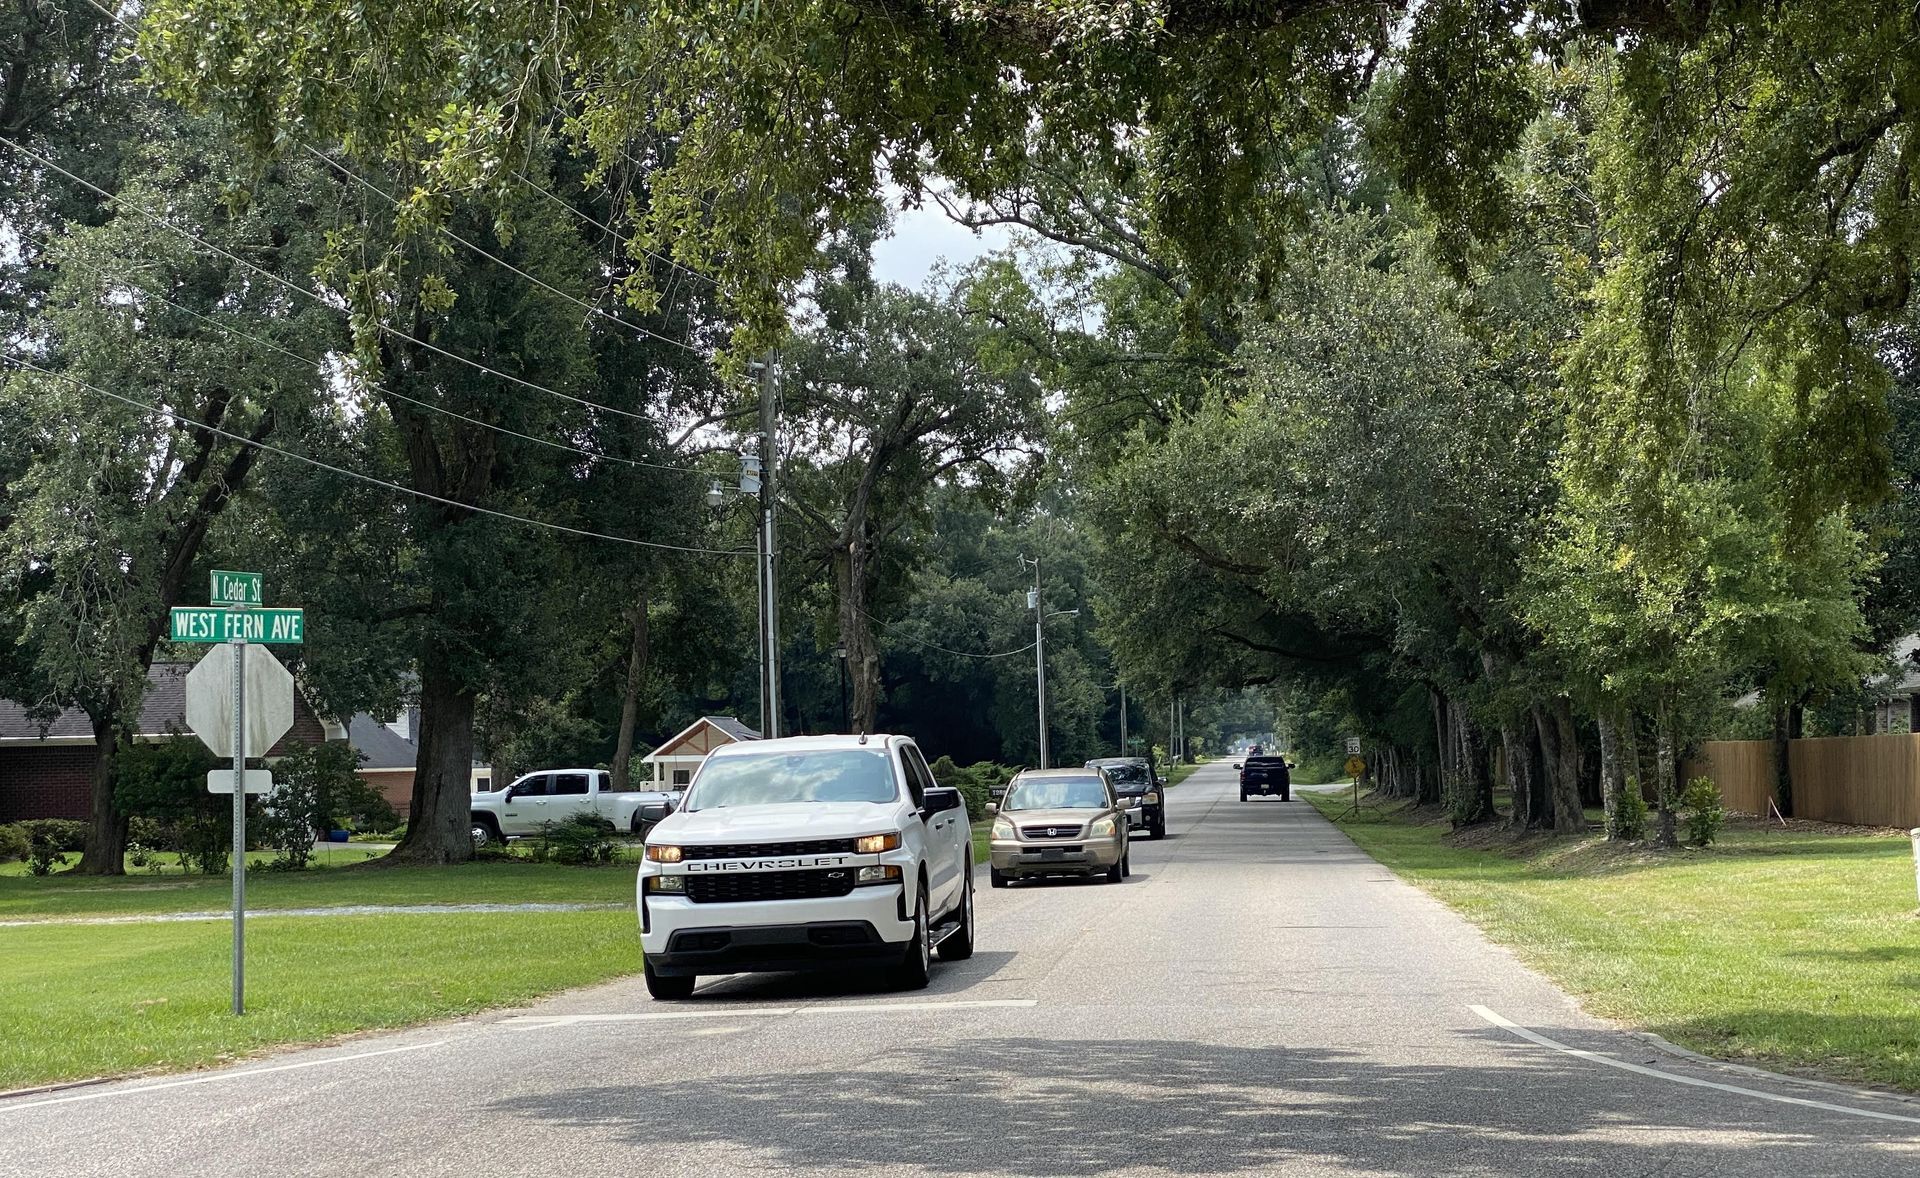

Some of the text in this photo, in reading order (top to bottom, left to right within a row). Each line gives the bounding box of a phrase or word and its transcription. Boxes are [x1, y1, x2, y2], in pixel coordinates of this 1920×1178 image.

[212, 575, 261, 602] N Cedar St
[175, 612, 300, 640] WEST FERN AVE
[687, 857, 849, 872] CHEVROLET
